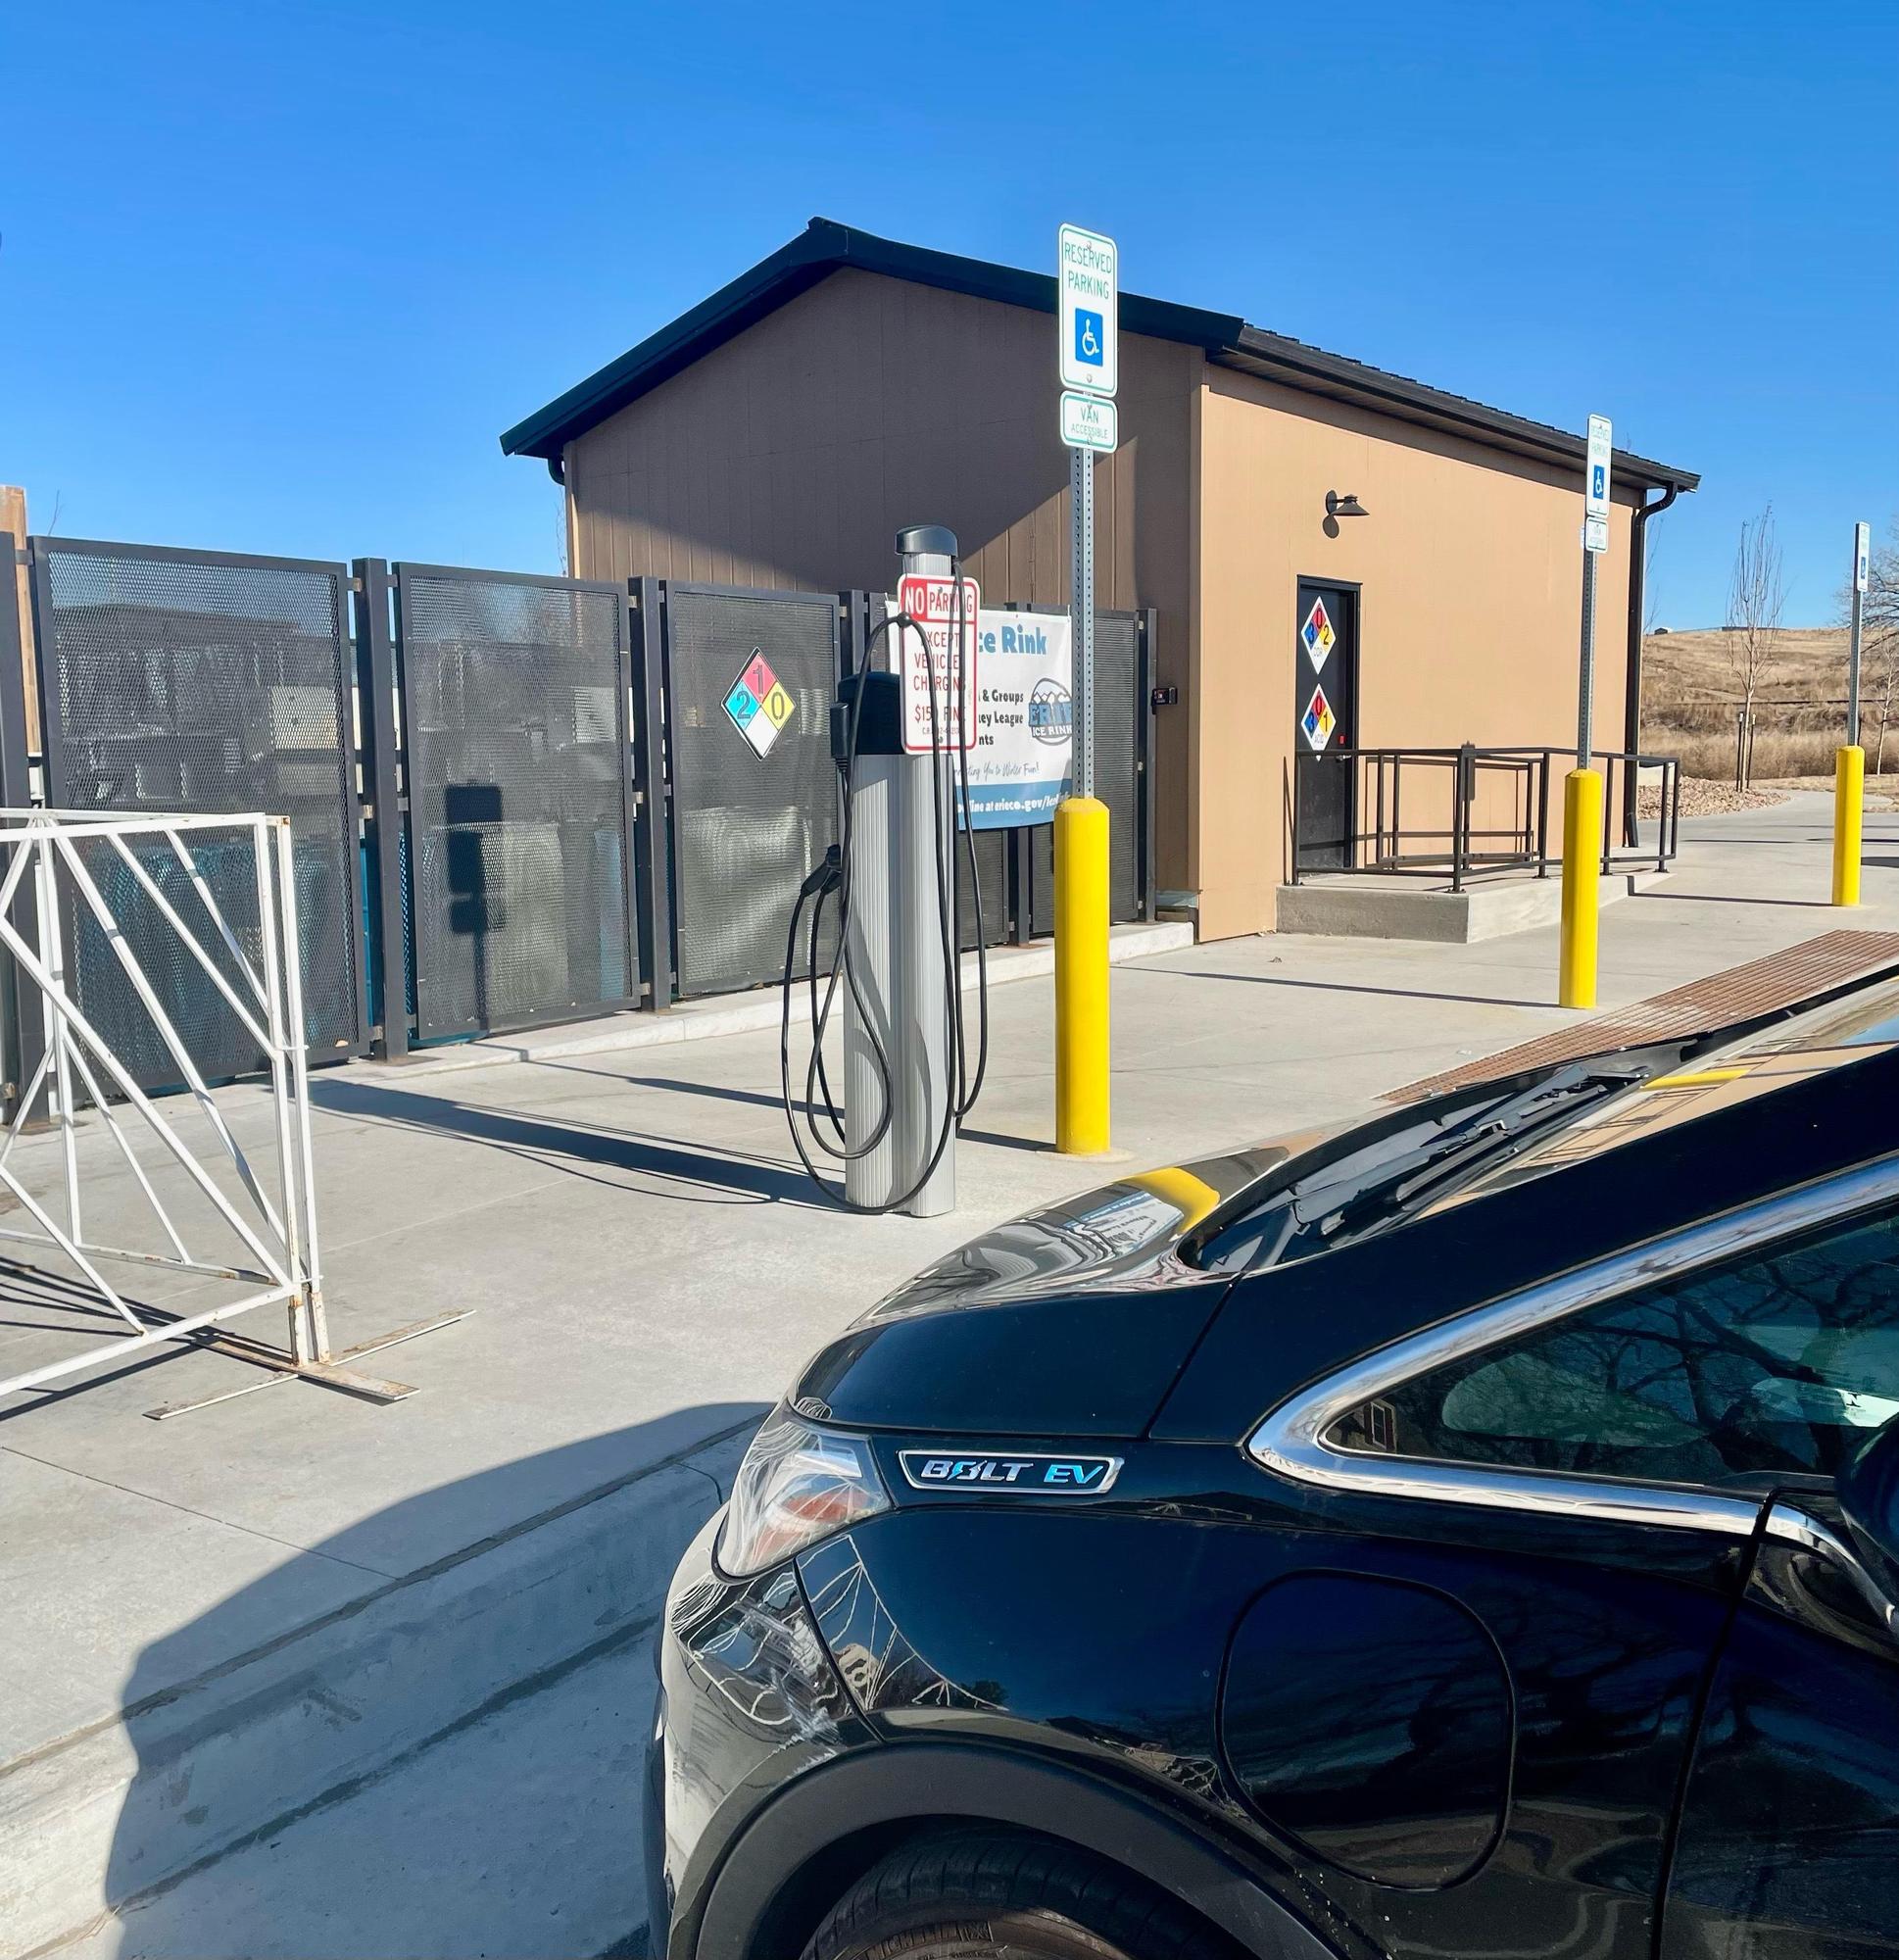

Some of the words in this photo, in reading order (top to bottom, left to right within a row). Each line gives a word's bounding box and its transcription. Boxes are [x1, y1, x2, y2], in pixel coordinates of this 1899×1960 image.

[1064, 241, 1112, 274] RESERVED
[1068, 270, 1109, 300] PARKING
[1080, 406, 1099, 424] VAN
[904, 586, 925, 615] NO
[1316, 607, 1323, 629] 0
[921, 630, 962, 648] XCEPT
[1001, 623, 1047, 656] Rink
[1307, 622, 1315, 645] 3
[1323, 623, 1330, 646] 2
[914, 652, 961, 670] VEICLE
[753, 664, 764, 696] 1
[737, 690, 751, 719] 2
[771, 691, 785, 720] 0
[982, 689, 990, 703] &
[992, 689, 1024, 706] Groups
[1315, 695, 1322, 716] 0
[914, 703, 937, 723] $15
[994, 710, 1024, 728] League
[1308, 711, 1315, 734] 3
[1323, 711, 1328, 733] 1
[1032, 726, 1047, 737] ICE
[920, 1459, 1034, 1482] BOLT
[1044, 1464, 1103, 1484] EV
